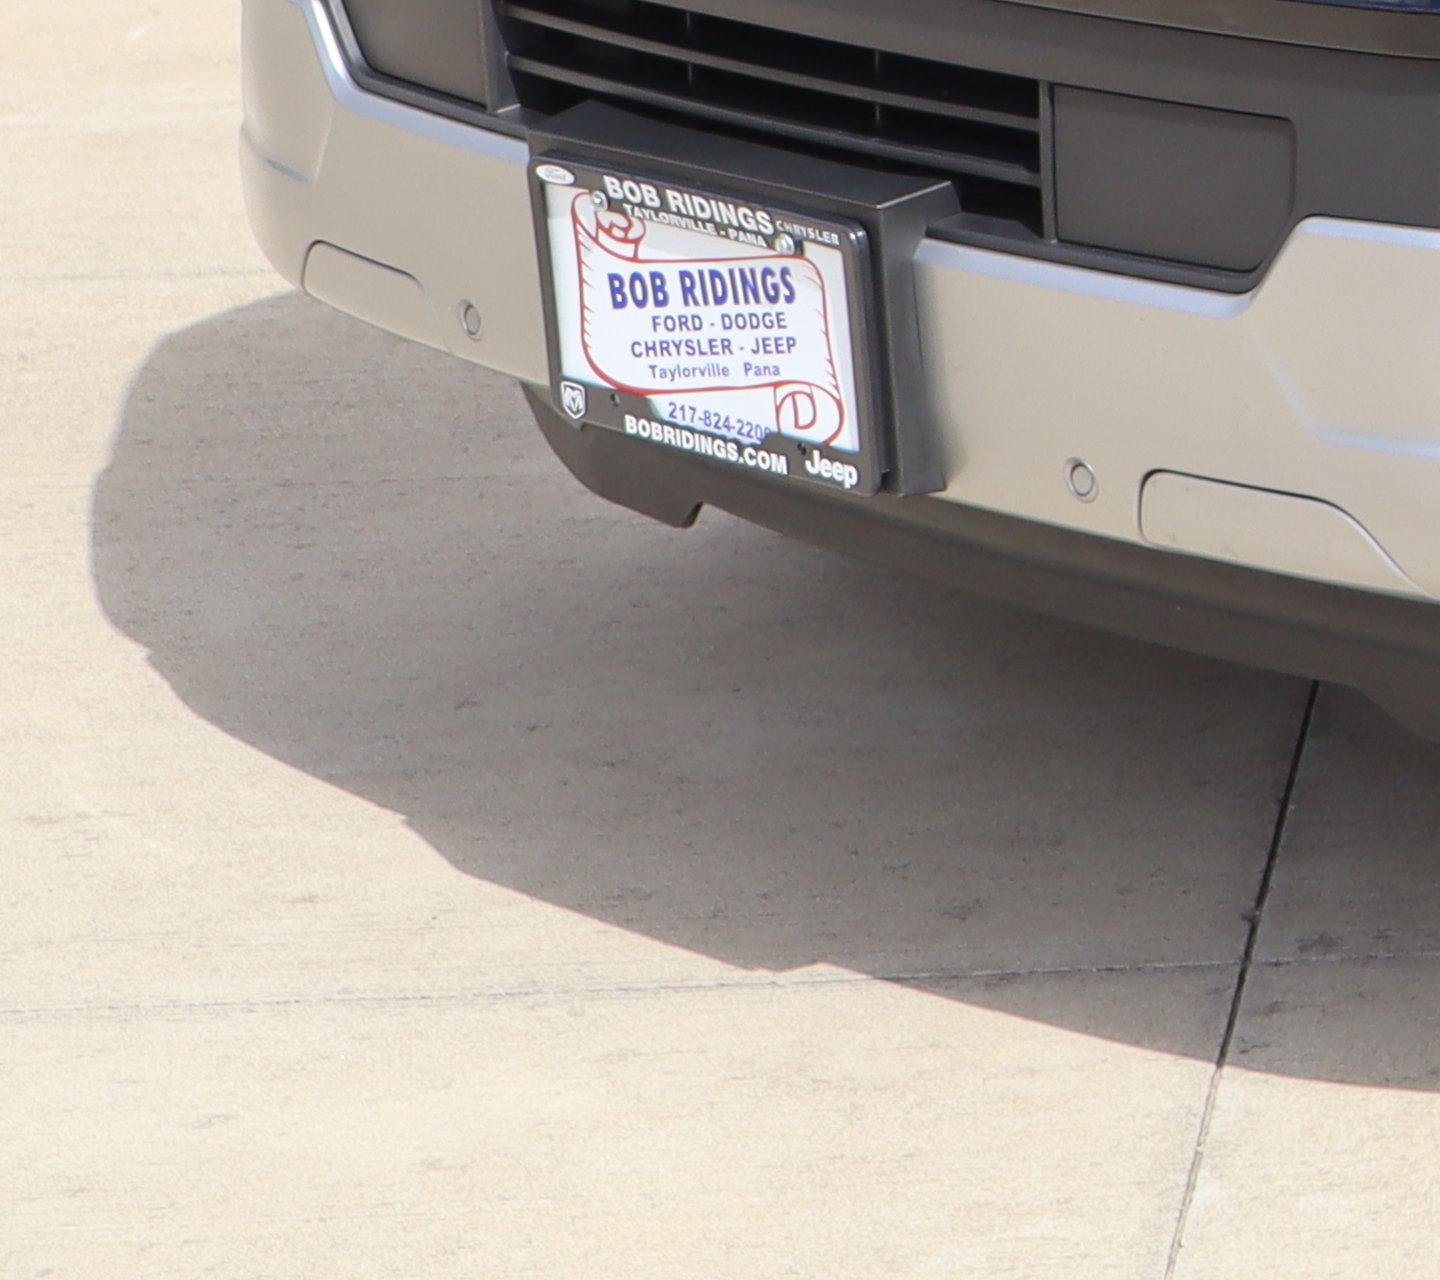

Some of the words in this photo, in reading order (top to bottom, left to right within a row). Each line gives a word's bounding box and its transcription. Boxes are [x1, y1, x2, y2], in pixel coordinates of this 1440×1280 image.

[603, 175, 661, 209] BOB
[666, 189, 774, 236] RIDINGS
[622, 203, 717, 236] TAYLORVILLE
[727, 227, 768, 248] PANA
[775, 220, 840, 246] CHRYSLER
[607, 271, 670, 310] BOB
[678, 266, 796, 307] RIDINGS
[651, 314, 703, 333] FORD
[720, 311, 787, 330] DODGE
[630, 338, 733, 358] CHRYSLER
[751, 336, 797, 355] JEEP
[649, 363, 730, 382] Taylorville
[744, 362, 781, 377] Pana
[624, 414, 788, 475] BOBRIDINGS.COM
[805, 449, 859, 488] Jeep
